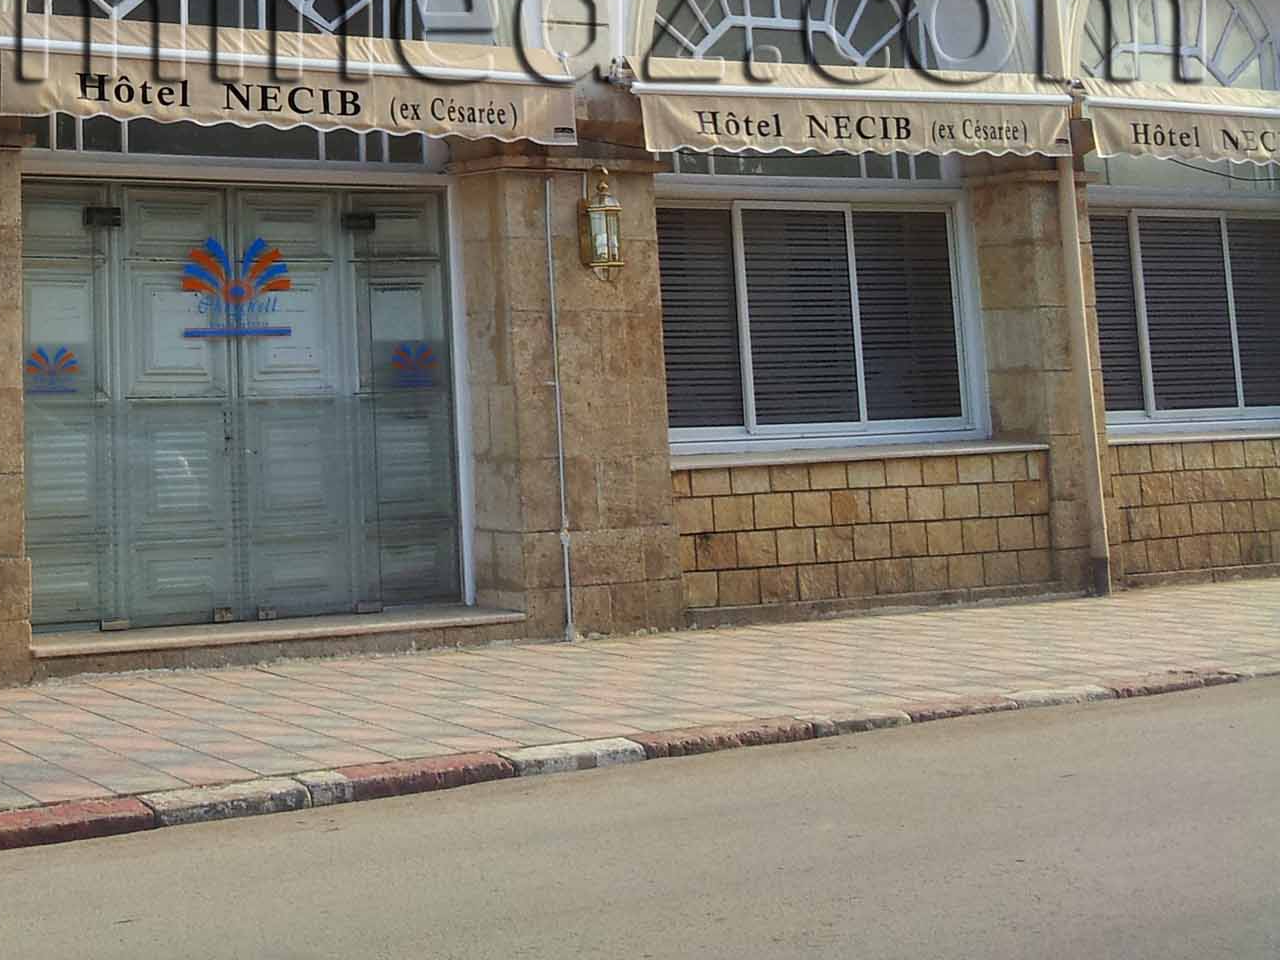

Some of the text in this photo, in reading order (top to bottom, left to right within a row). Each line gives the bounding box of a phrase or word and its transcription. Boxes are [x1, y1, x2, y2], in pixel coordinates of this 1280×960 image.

[75, 71, 519, 131] Hôtel NECIB (ex Césarée)
[694, 110, 784, 138] Hôtel
[806, 114, 912, 140] NECIB
[931, 119, 955, 145] (ex
[1131, 122, 1280, 153] Hôtel NEC
